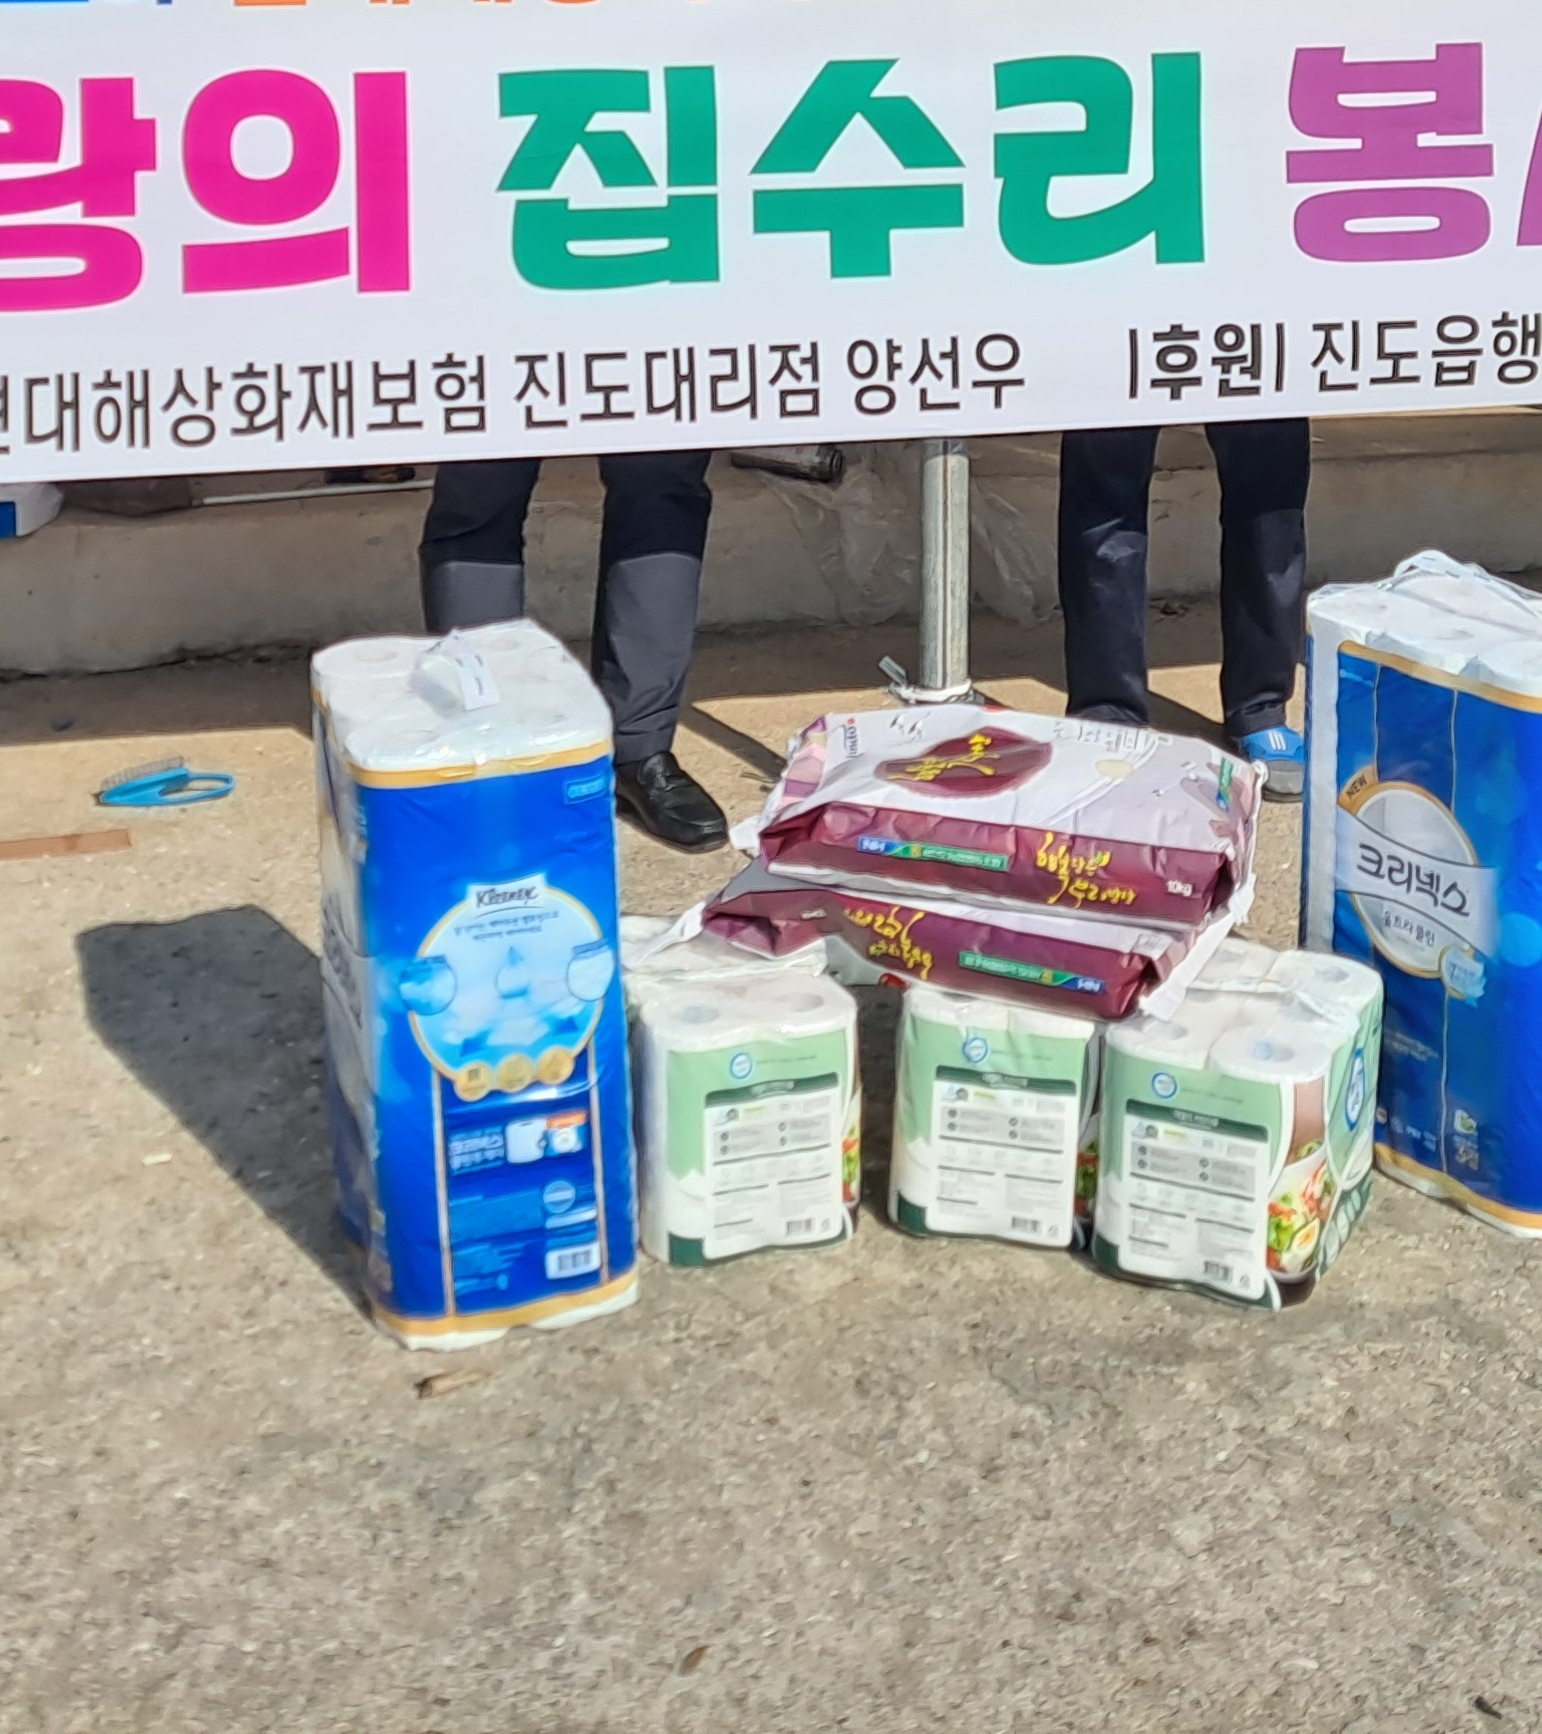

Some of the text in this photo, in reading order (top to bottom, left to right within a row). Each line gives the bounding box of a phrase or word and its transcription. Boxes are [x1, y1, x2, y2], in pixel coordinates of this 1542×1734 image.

[496, 50, 1206, 292] 집수리
[514, 339, 821, 430] 진도대리점
[846, 332, 1026, 416] 양선우
[1346, 774, 1368, 800] NEW
[1356, 840, 1471, 918] 크리넥스
